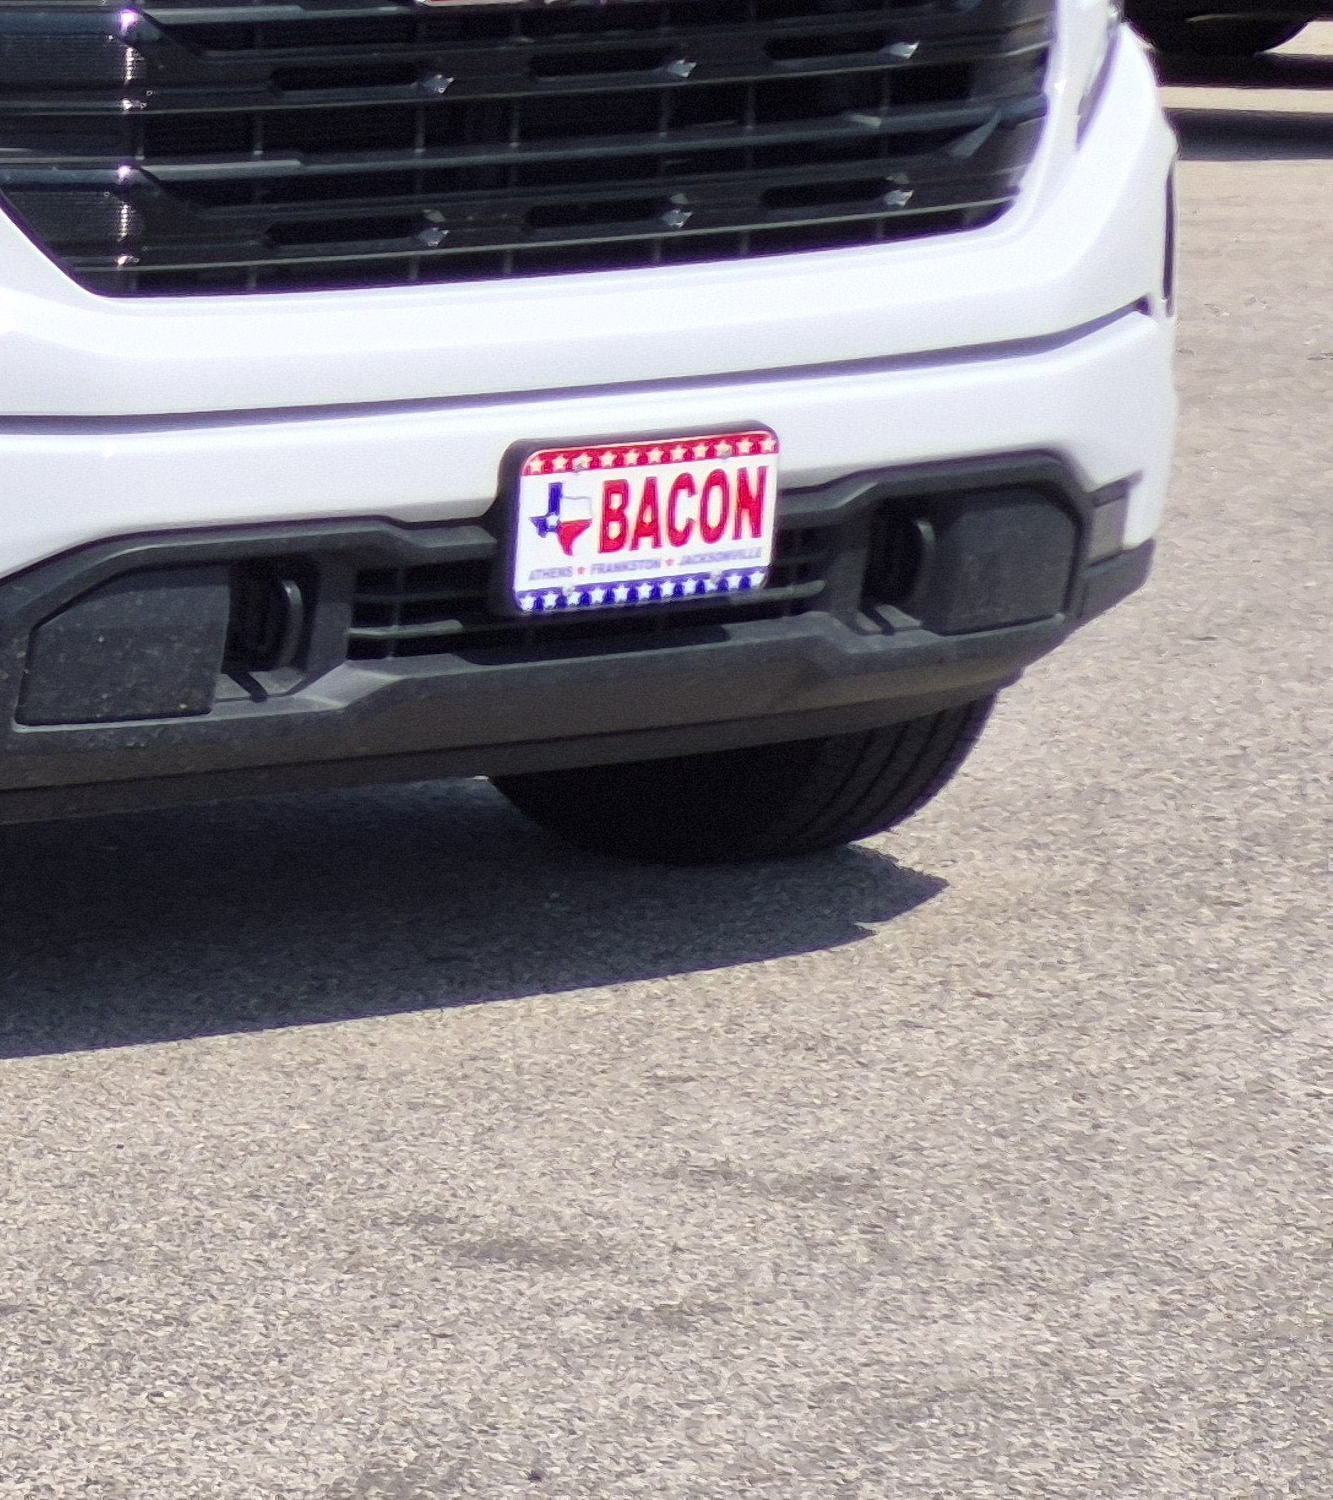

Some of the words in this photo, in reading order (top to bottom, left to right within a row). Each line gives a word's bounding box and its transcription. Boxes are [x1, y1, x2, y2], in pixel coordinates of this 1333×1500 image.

[598, 466, 769, 555] BACON
[528, 566, 573, 581] ATHENS
[590, 559, 661, 575] FRANKSTON
